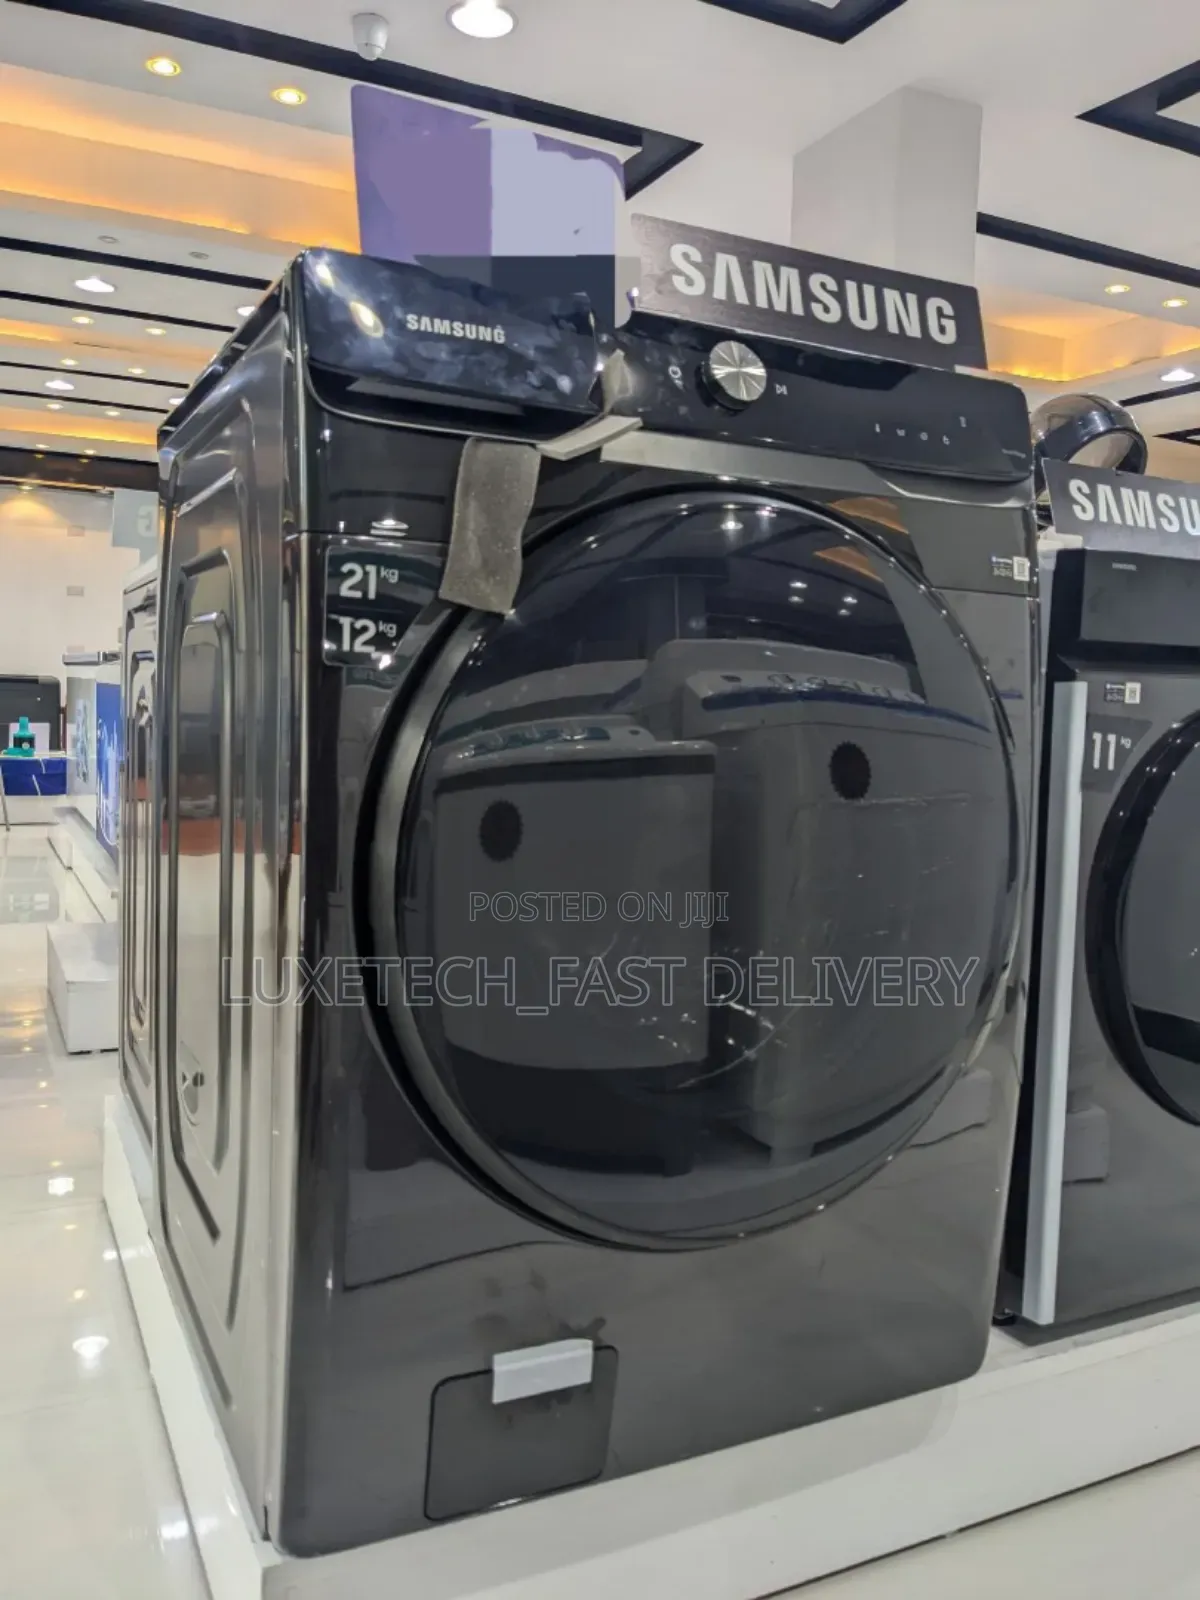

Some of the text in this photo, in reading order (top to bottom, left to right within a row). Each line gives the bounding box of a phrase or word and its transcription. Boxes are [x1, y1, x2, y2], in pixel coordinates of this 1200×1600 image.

[669, 243, 957, 344] SAMSUNG
[405, 313, 506, 344] SAMSUNG
[1068, 478, 1200, 536] SAMSU
